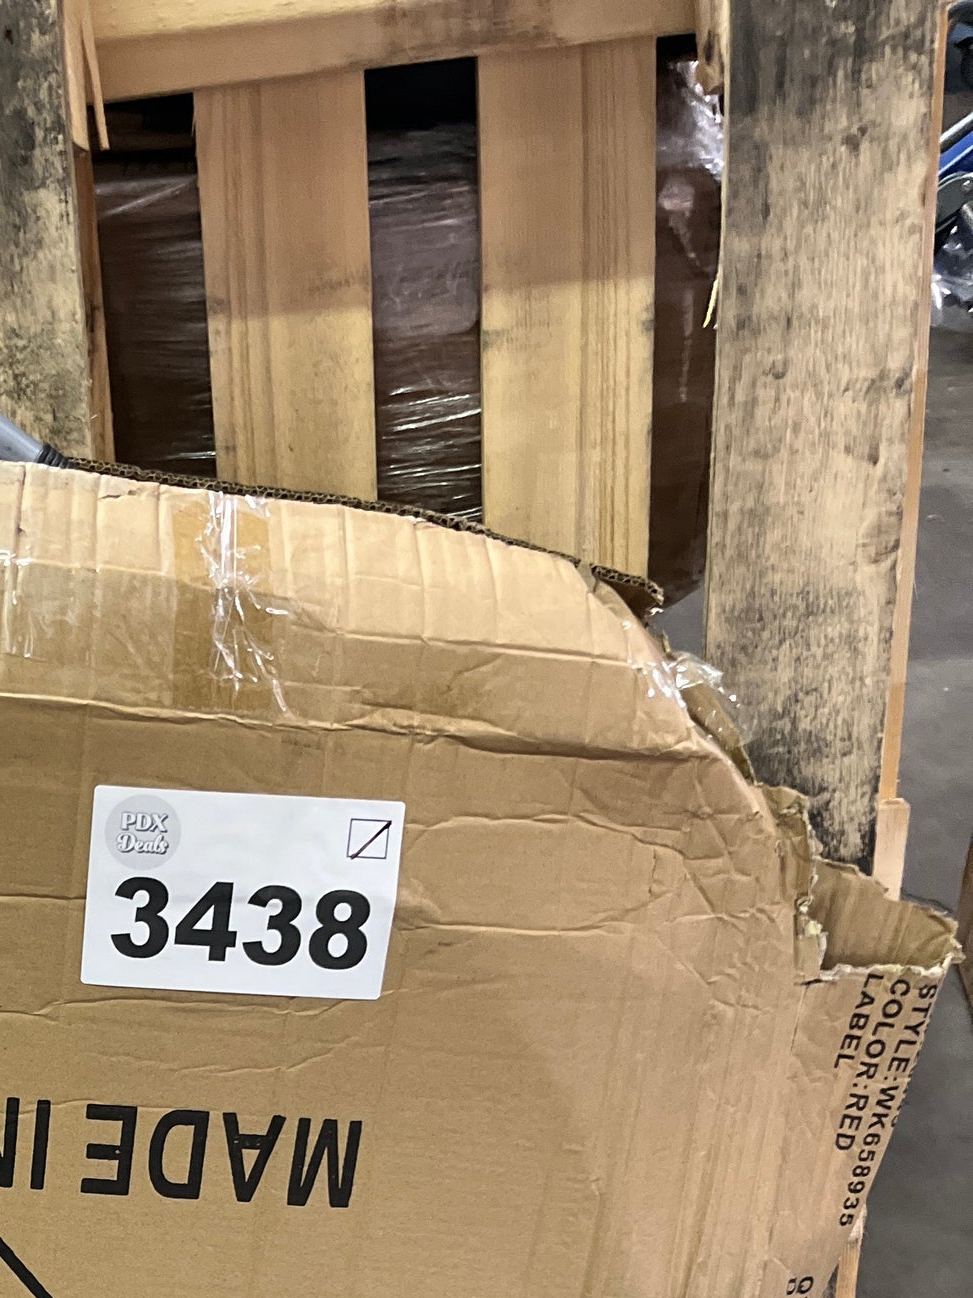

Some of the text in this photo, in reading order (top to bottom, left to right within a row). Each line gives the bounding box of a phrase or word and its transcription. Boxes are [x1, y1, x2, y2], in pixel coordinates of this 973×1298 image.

[116, 832, 169, 855] Deals
[120, 811, 168, 833] PDX
[110, 876, 371, 970] 3438
[834, 973, 884, 1069] LABEL
[835, 979, 911, 1151] COLOR:RED
[839, 984, 937, 1226] STYLE:WK658935
[80, 1103, 363, 1208] MADE
